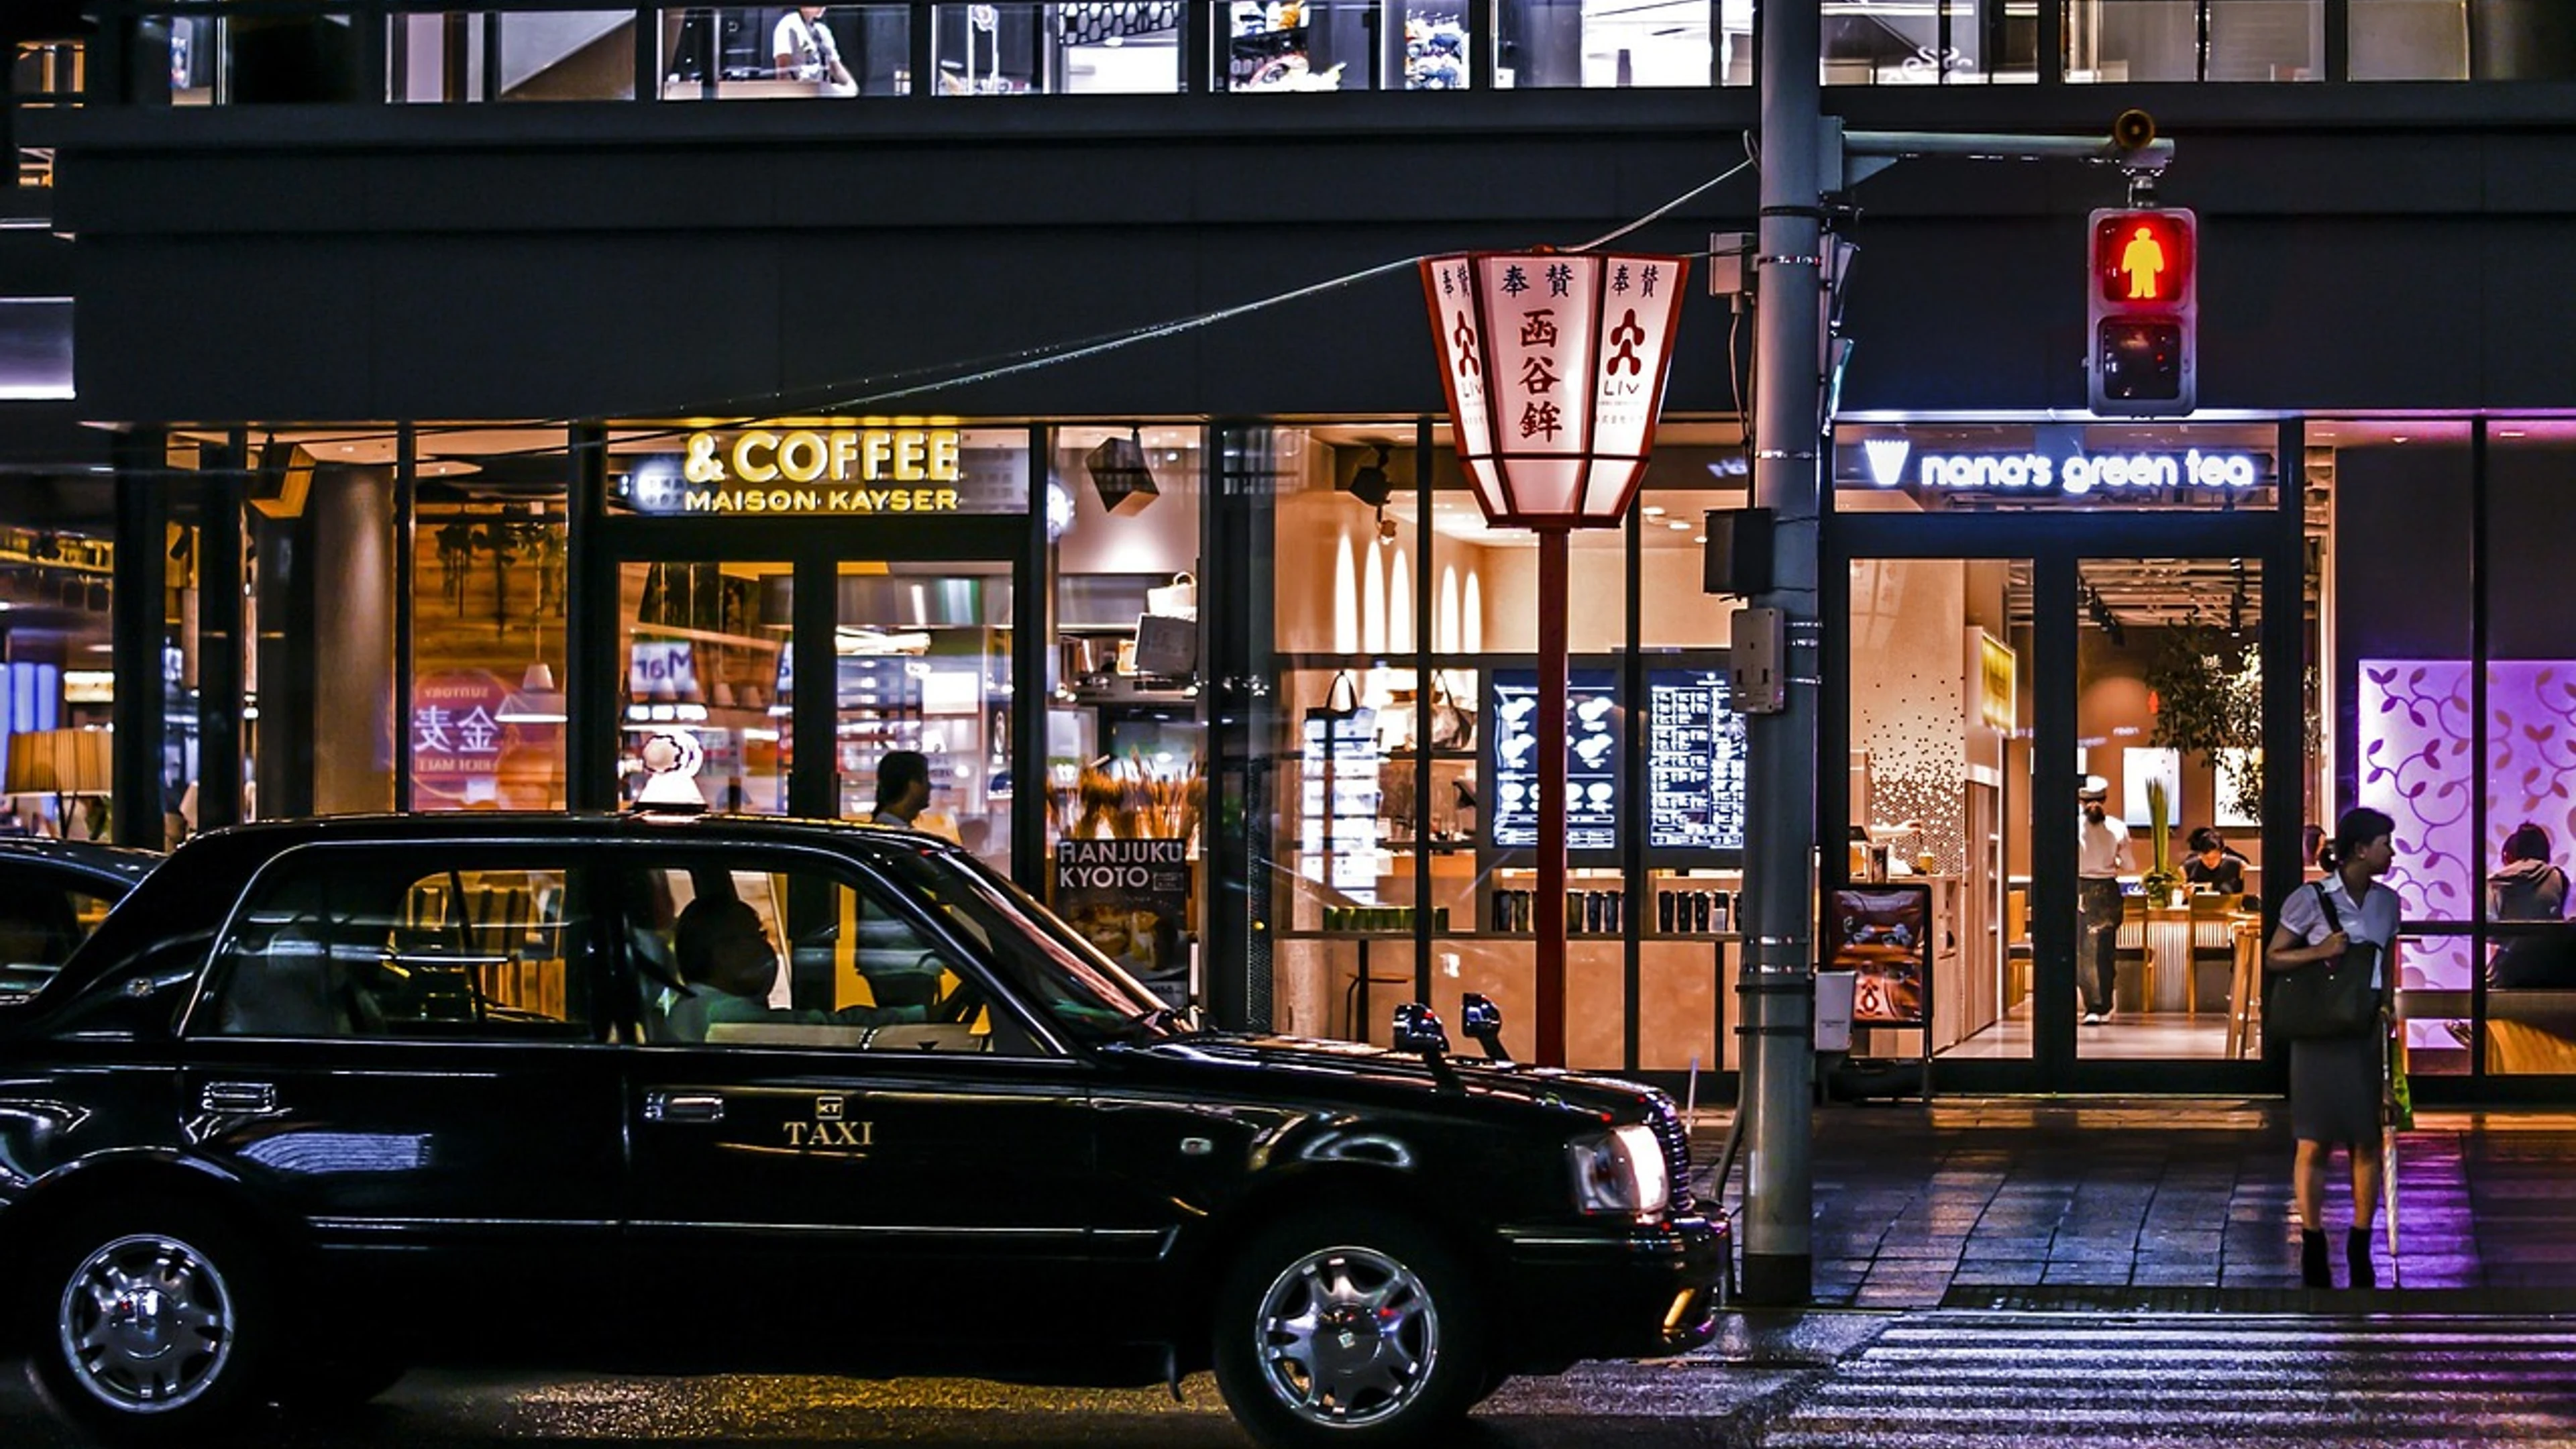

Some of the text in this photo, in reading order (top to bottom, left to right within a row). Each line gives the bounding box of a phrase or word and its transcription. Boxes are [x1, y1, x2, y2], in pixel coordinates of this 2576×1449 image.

[1501, 264, 1574, 298] 奉賛
[1611, 264, 1660, 298] 奉賛
[1519, 309, 1562, 443] 函谷鉾
[1604, 380, 1640, 396] LIV
[685, 430, 960, 483] & COFFEE
[1921, 448, 2254, 494] nana's green tea
[685, 490, 958, 512] MAISON KAYSER
[1059, 841, 1183, 863] HANJUKU
[1060, 866, 1149, 888] KYOTO
[783, 1122, 874, 1145] TAXI
